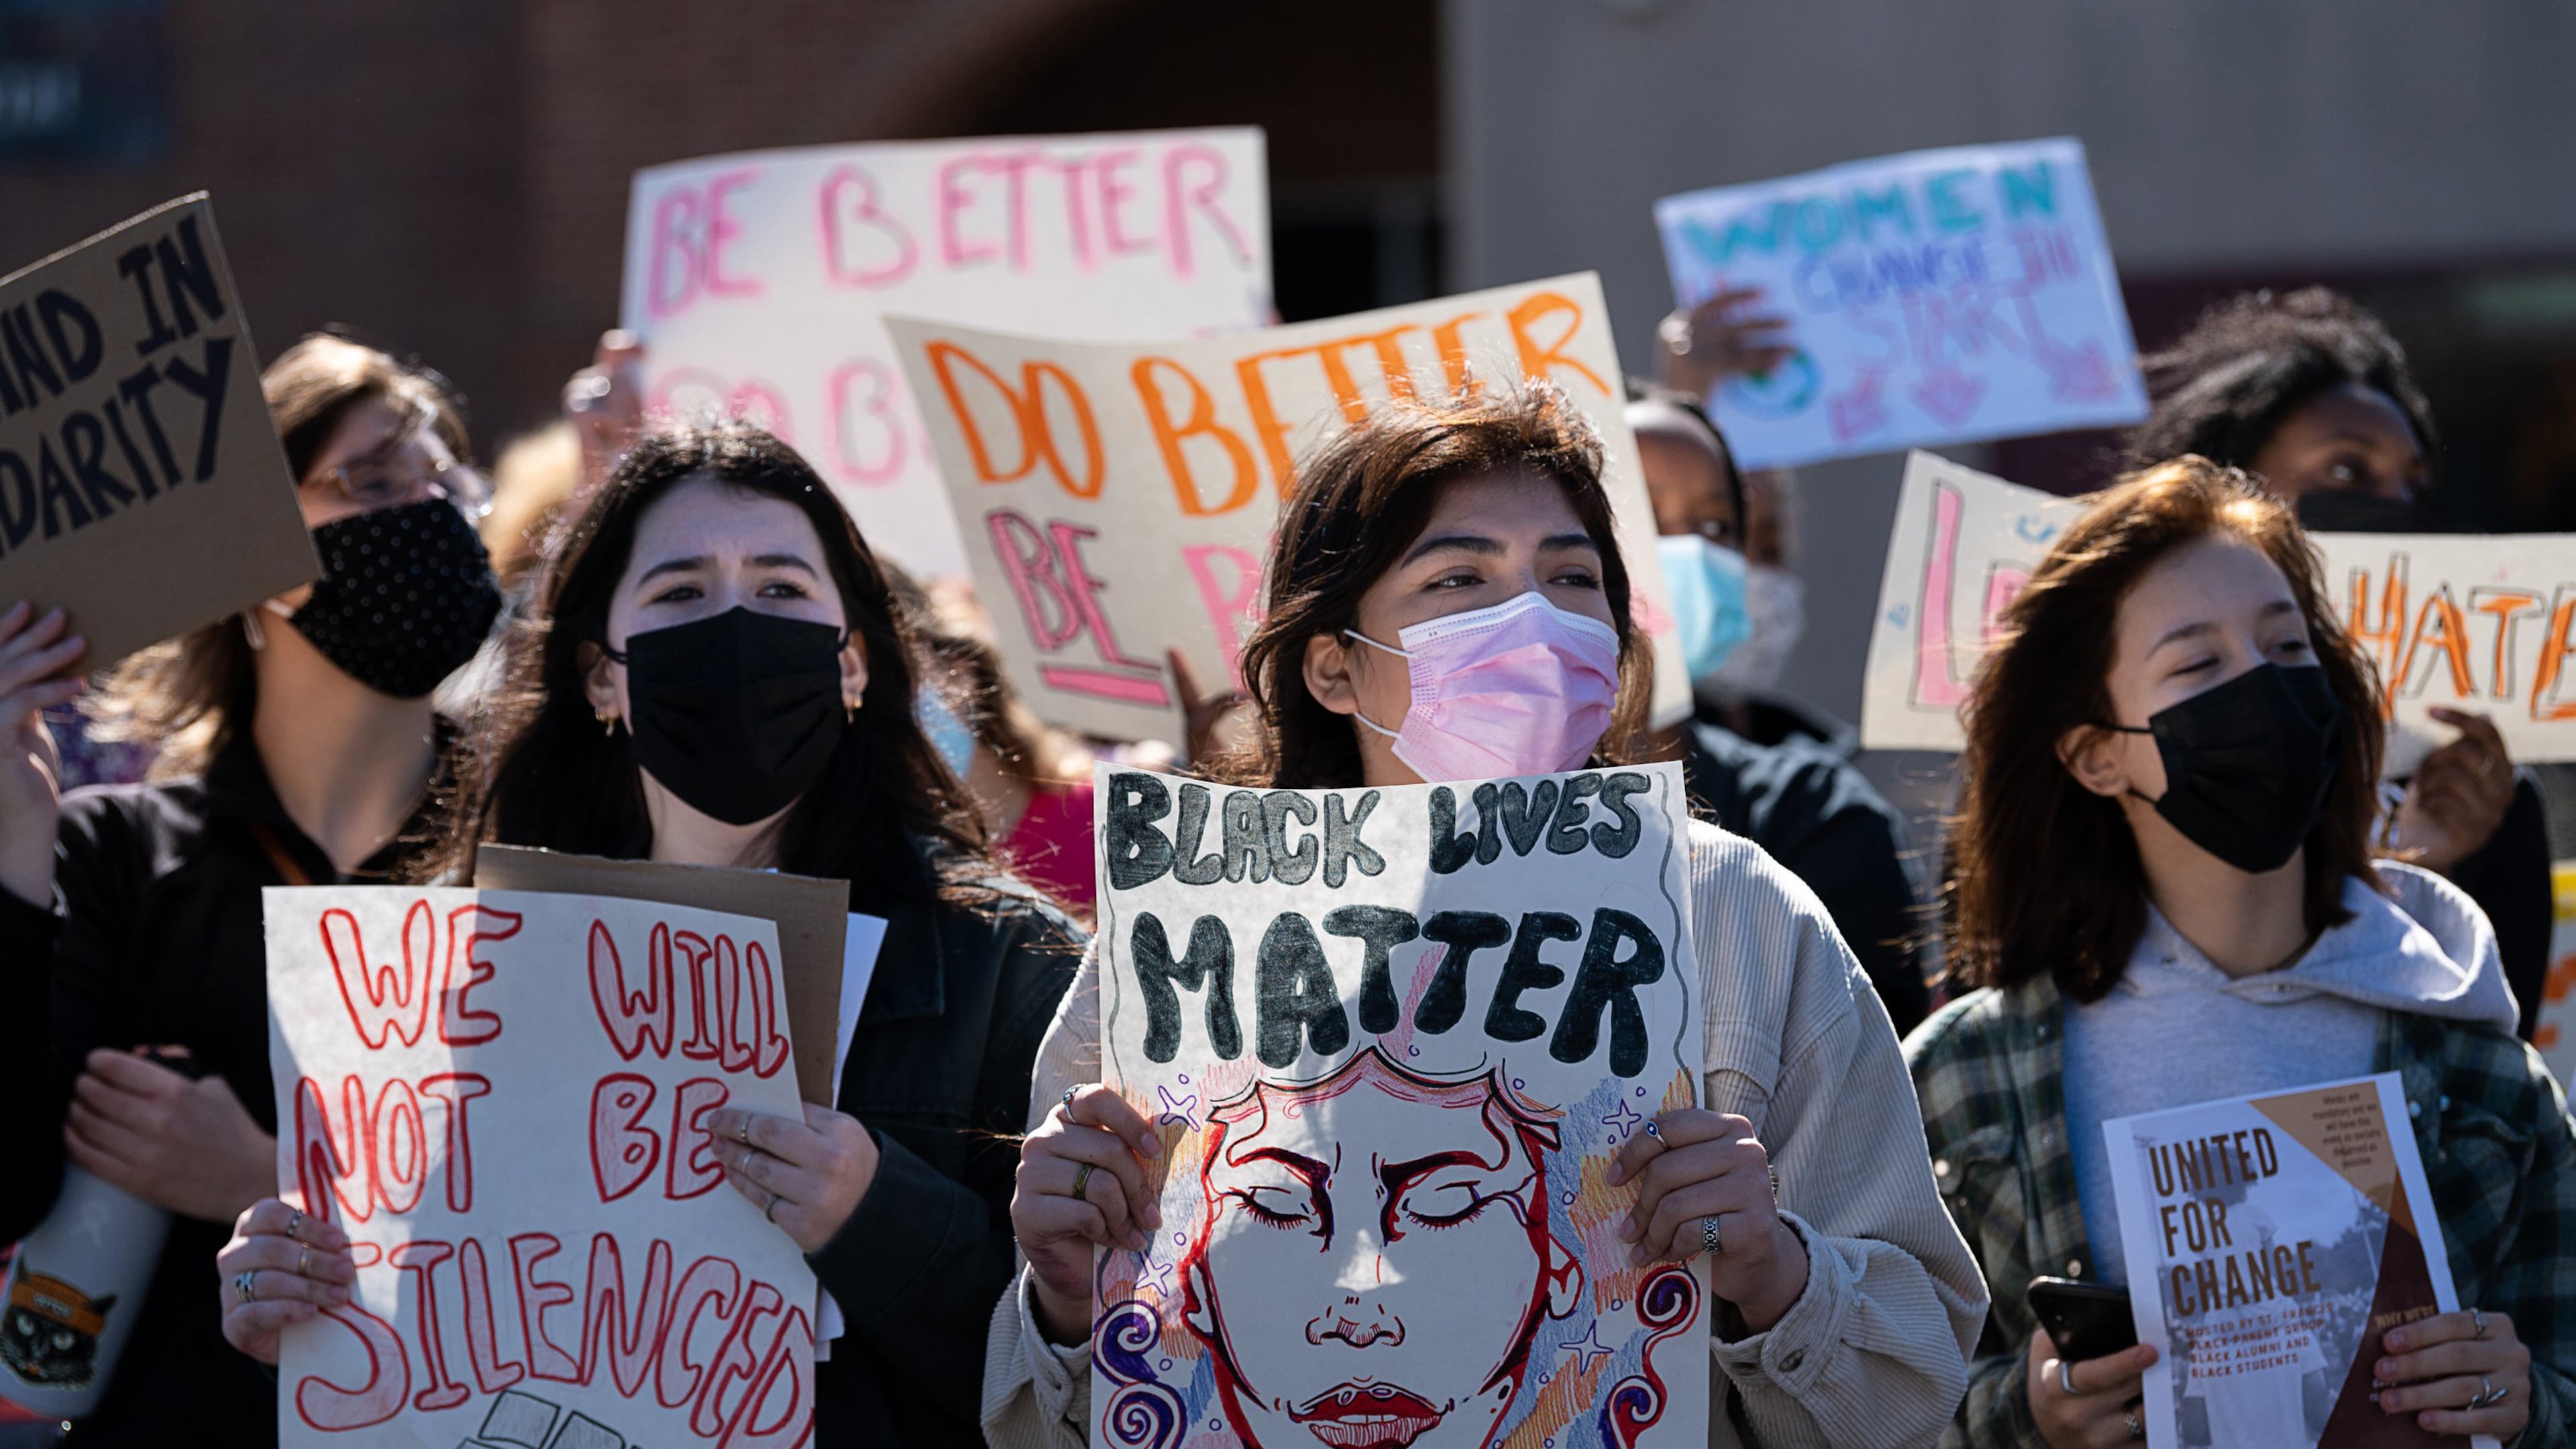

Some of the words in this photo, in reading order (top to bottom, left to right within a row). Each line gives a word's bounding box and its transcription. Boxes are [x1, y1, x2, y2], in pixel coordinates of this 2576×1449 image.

[648, 164, 769, 318] BE
[813, 142, 1257, 290] BETTER
[1680, 160, 2057, 264] WOMEN
[115, 214, 227, 356] IN
[0, 338, 235, 559] DARITY
[924, 339, 1106, 499] DO
[1131, 291, 1610, 517] BETTER
[986, 507, 1161, 669] BE
[1107, 771, 1386, 890] BLACK
[1428, 771, 1651, 875] LIVES
[320, 898, 522, 1050] WE
[586, 919, 790, 1075] WILL
[1130, 904, 1666, 1077] MATTER
[294, 1072, 491, 1224] NOT
[589, 1072, 730, 1204] BE
[2149, 1128, 2278, 1197] UNITED
[2161, 1197, 2233, 1257] FOR
[2171, 1240, 2321, 1317] CHANGE
[295, 1232, 815, 1449] SILENCED
[2187, 1320, 2235, 1338] HOSTED
[2239, 1317, 2253, 1329] BY
[2188, 1335, 2228, 1350] BLACK
[2233, 1326, 2279, 1344] PARENT
[2284, 1318, 2324, 1335] GROUP
[2188, 1350, 2231, 1364] BLACK
[2235, 1342, 2282, 1360] ALUMNI
[2286, 1335, 2309, 1350] AND
[2190, 1365, 2232, 1379] BLACK
[2236, 1354, 2299, 1374] STUDENTS
